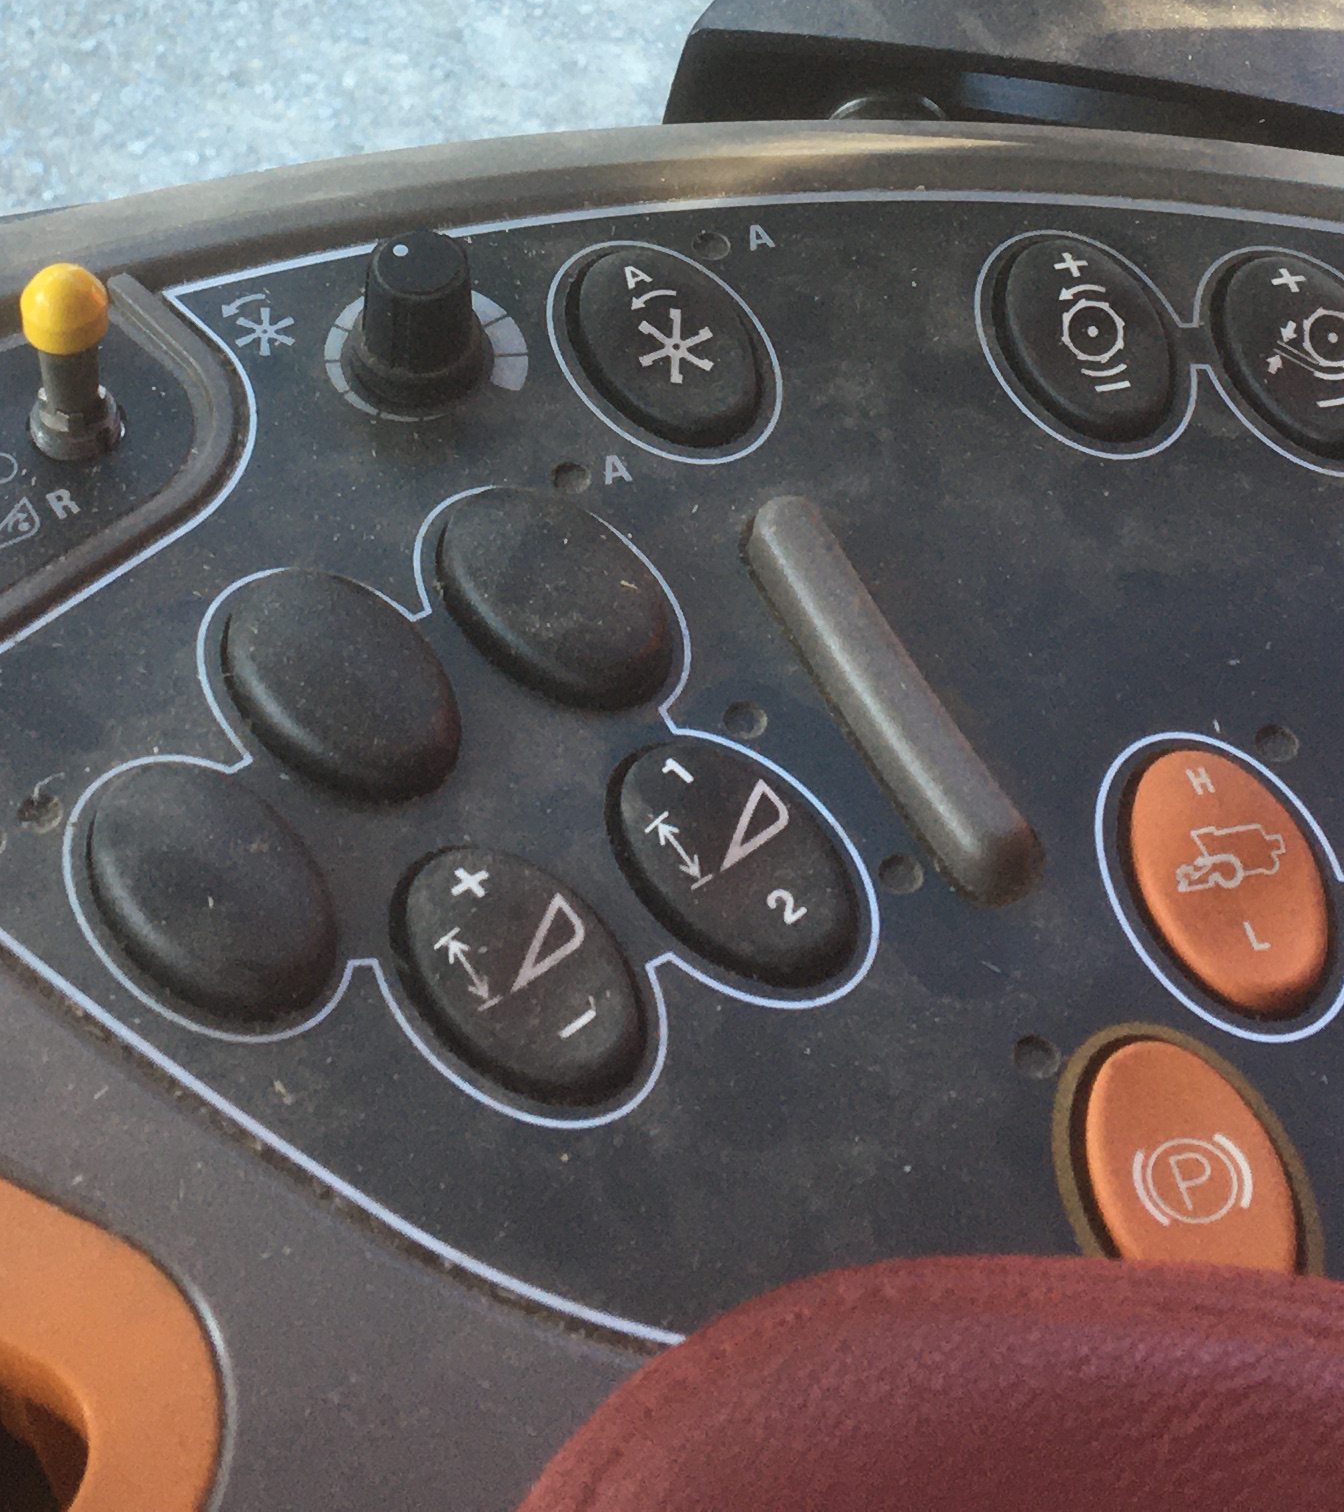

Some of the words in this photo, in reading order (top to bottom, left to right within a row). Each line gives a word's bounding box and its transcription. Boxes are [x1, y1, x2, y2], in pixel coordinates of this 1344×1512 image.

[747, 223, 776, 251] A
[623, 264, 653, 289] A
[602, 454, 633, 485] A
[45, 488, 81, 521] R
[661, 757, 695, 784] 1
[1185, 767, 1215, 795] H
[766, 888, 807, 925] 2
[1242, 921, 1271, 951] L
[1169, 1152, 1211, 1211] P
